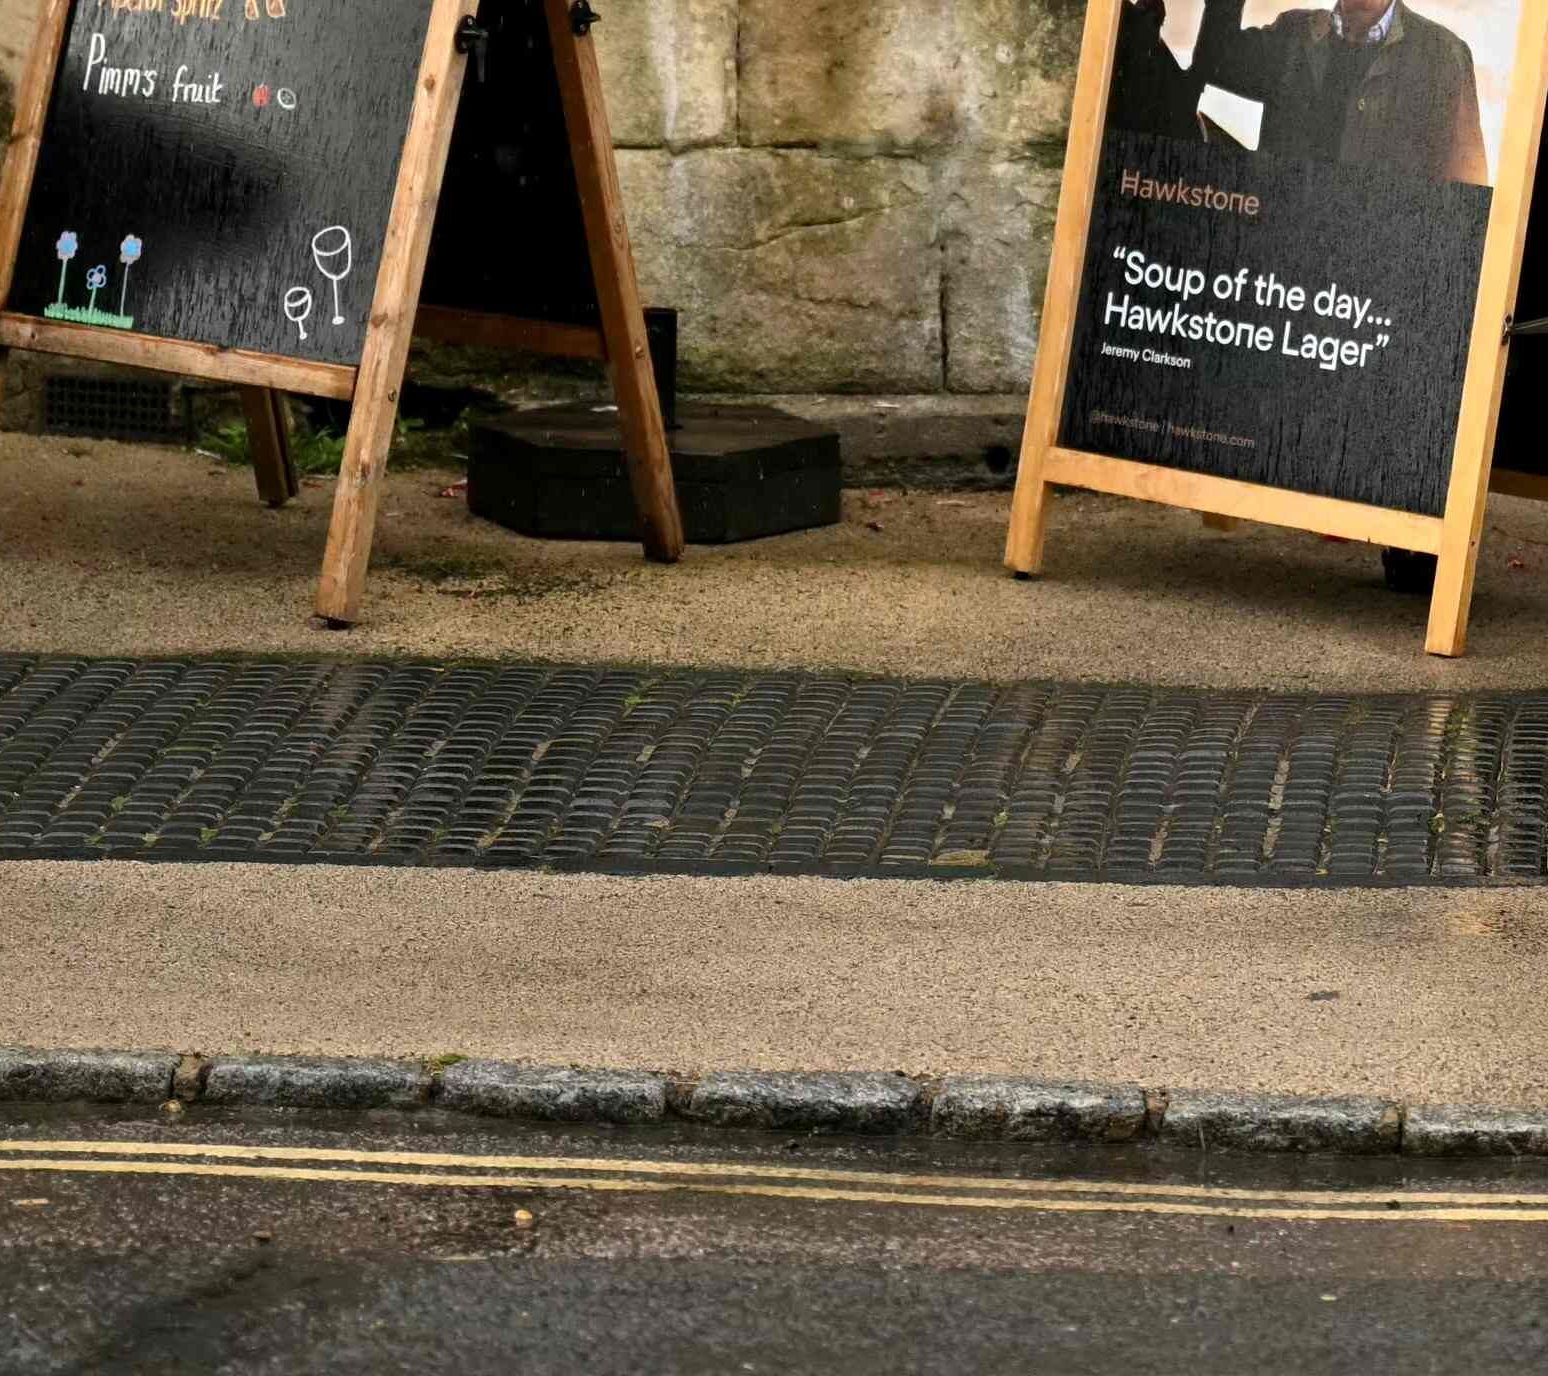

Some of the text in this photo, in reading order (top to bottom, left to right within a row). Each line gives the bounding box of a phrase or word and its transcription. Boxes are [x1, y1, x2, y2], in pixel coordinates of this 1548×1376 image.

[172, 64, 224, 104] fruit
[1120, 168, 1260, 215] Hawkstone
[1213, 268, 1249, 302] of
[1254, 273, 1306, 311] the
[1104, 292, 1274, 351] Hawkstone
[1101, 342, 1191, 369] Jeremy Clarkson
